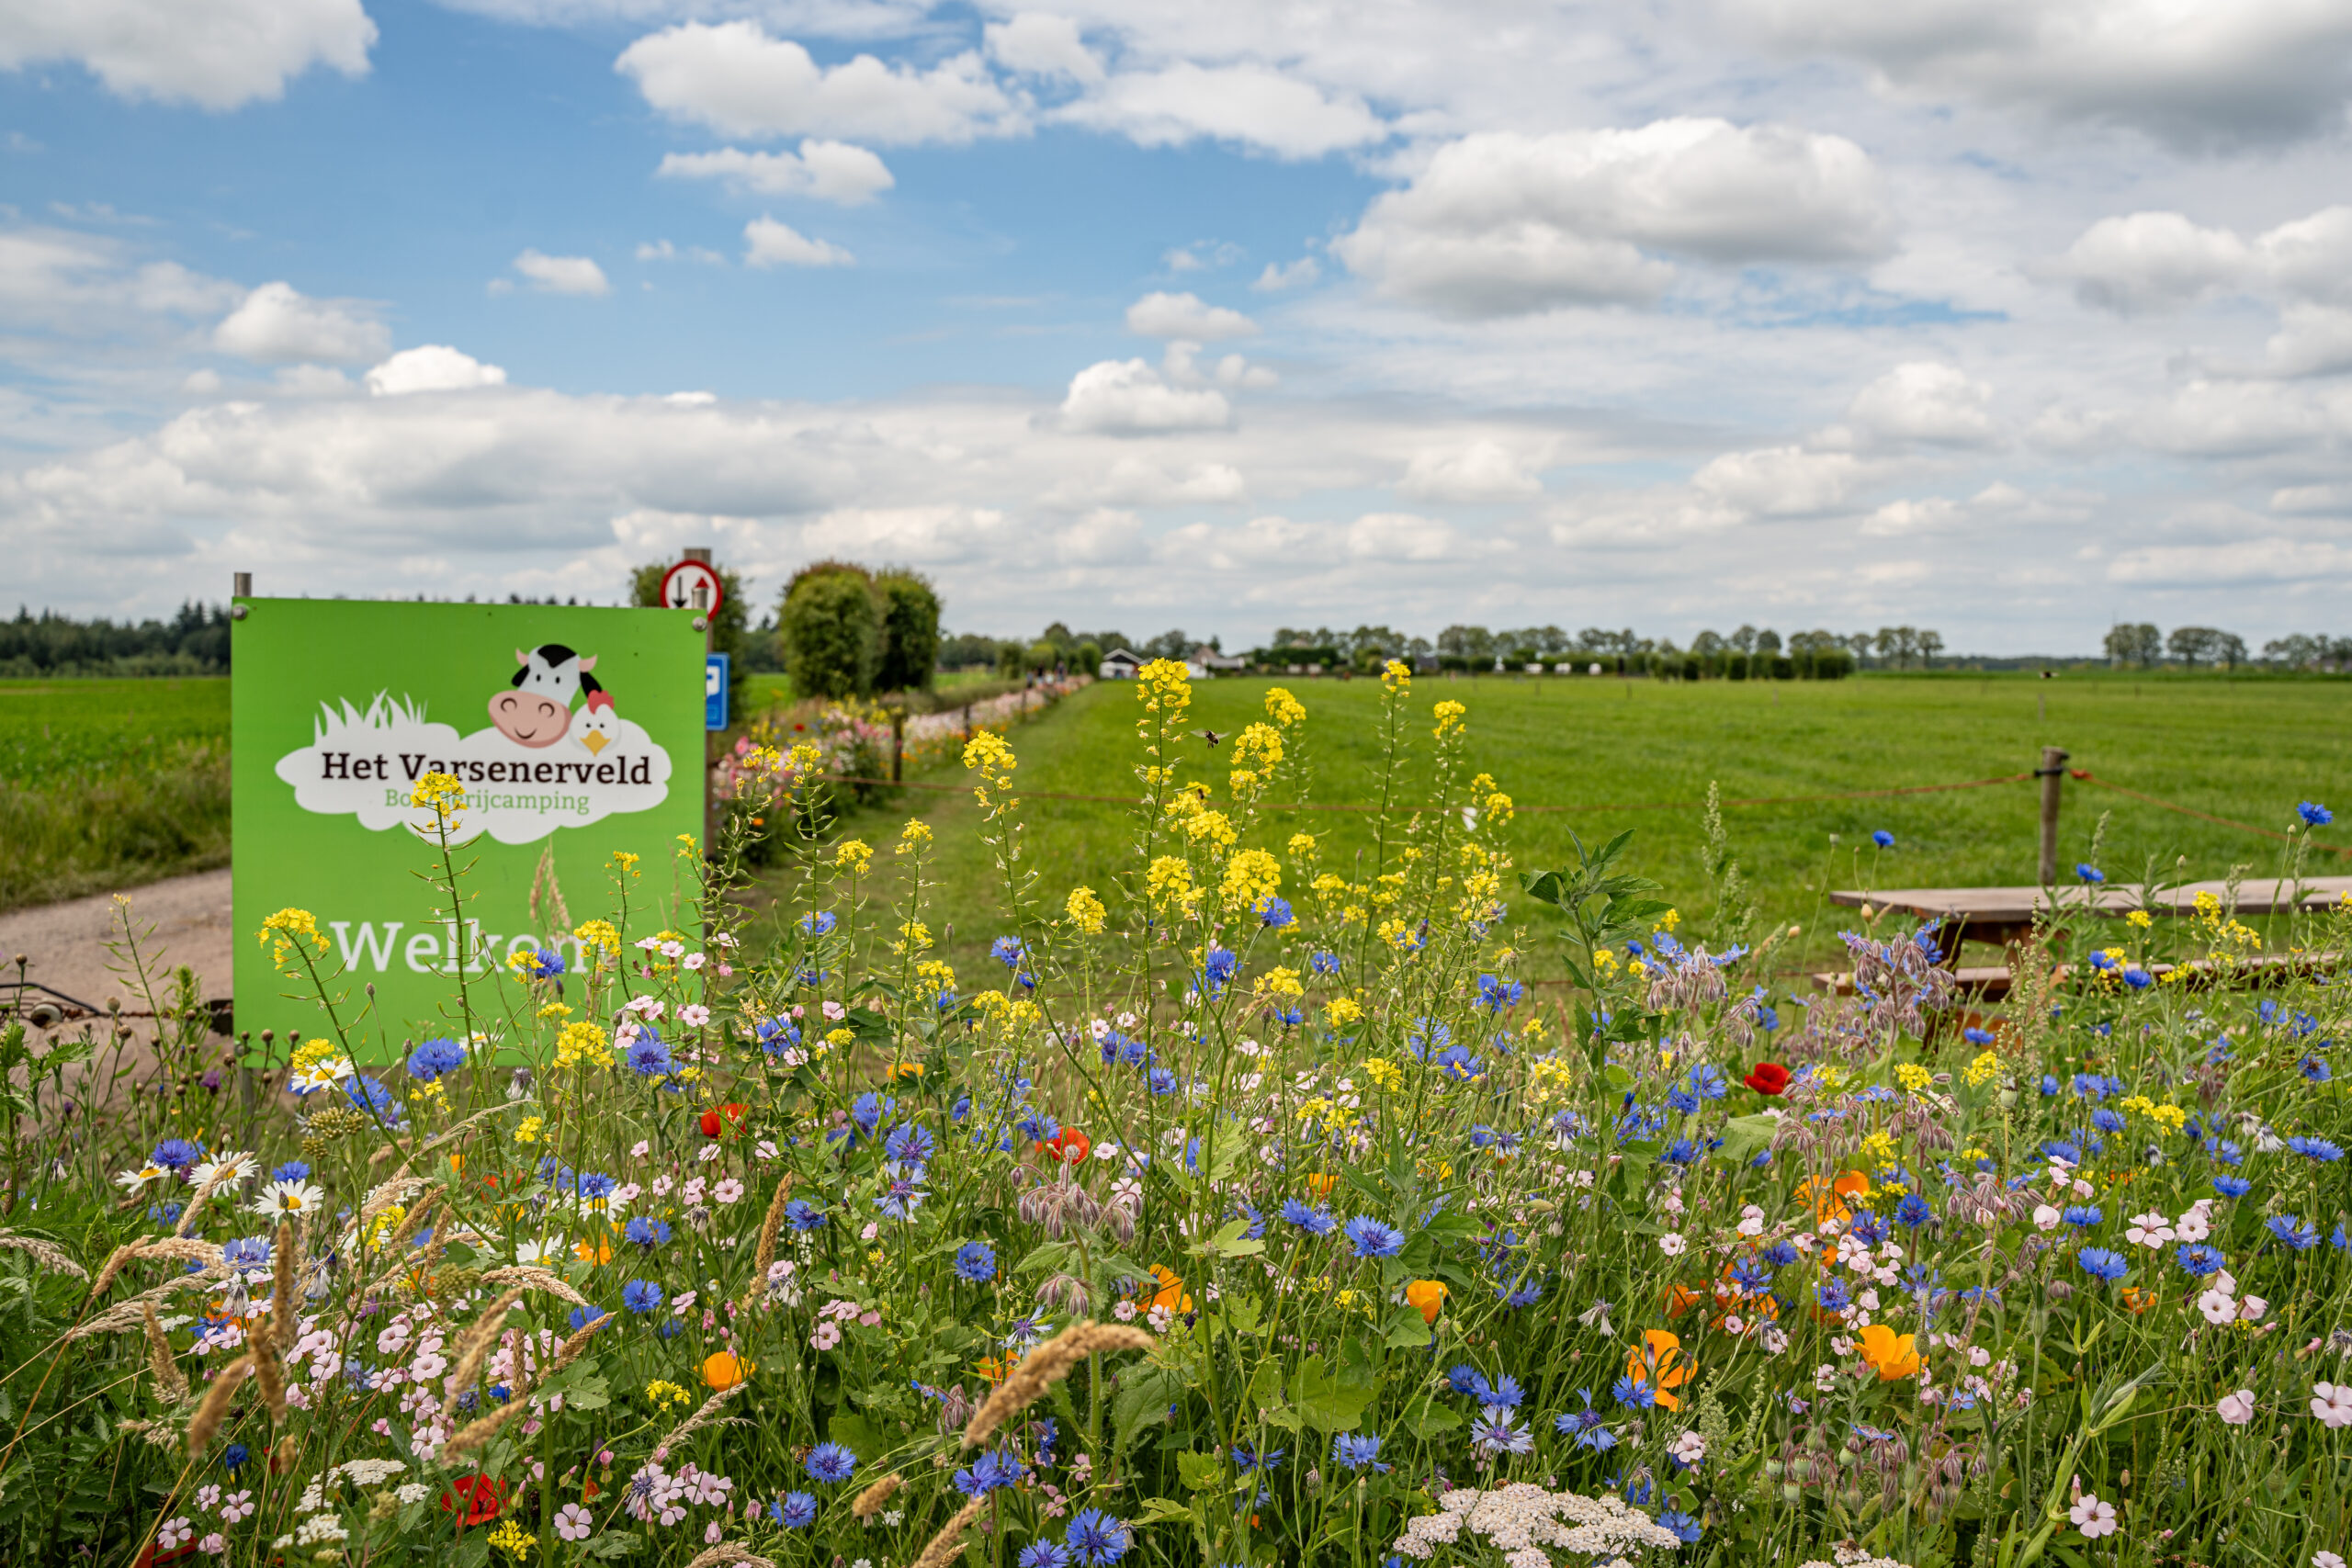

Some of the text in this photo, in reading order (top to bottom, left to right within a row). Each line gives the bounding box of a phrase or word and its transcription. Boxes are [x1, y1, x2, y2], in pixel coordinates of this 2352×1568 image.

[322, 752, 652, 785] Het Varsenerveld
[384, 788, 590, 815] Boerijcamping
